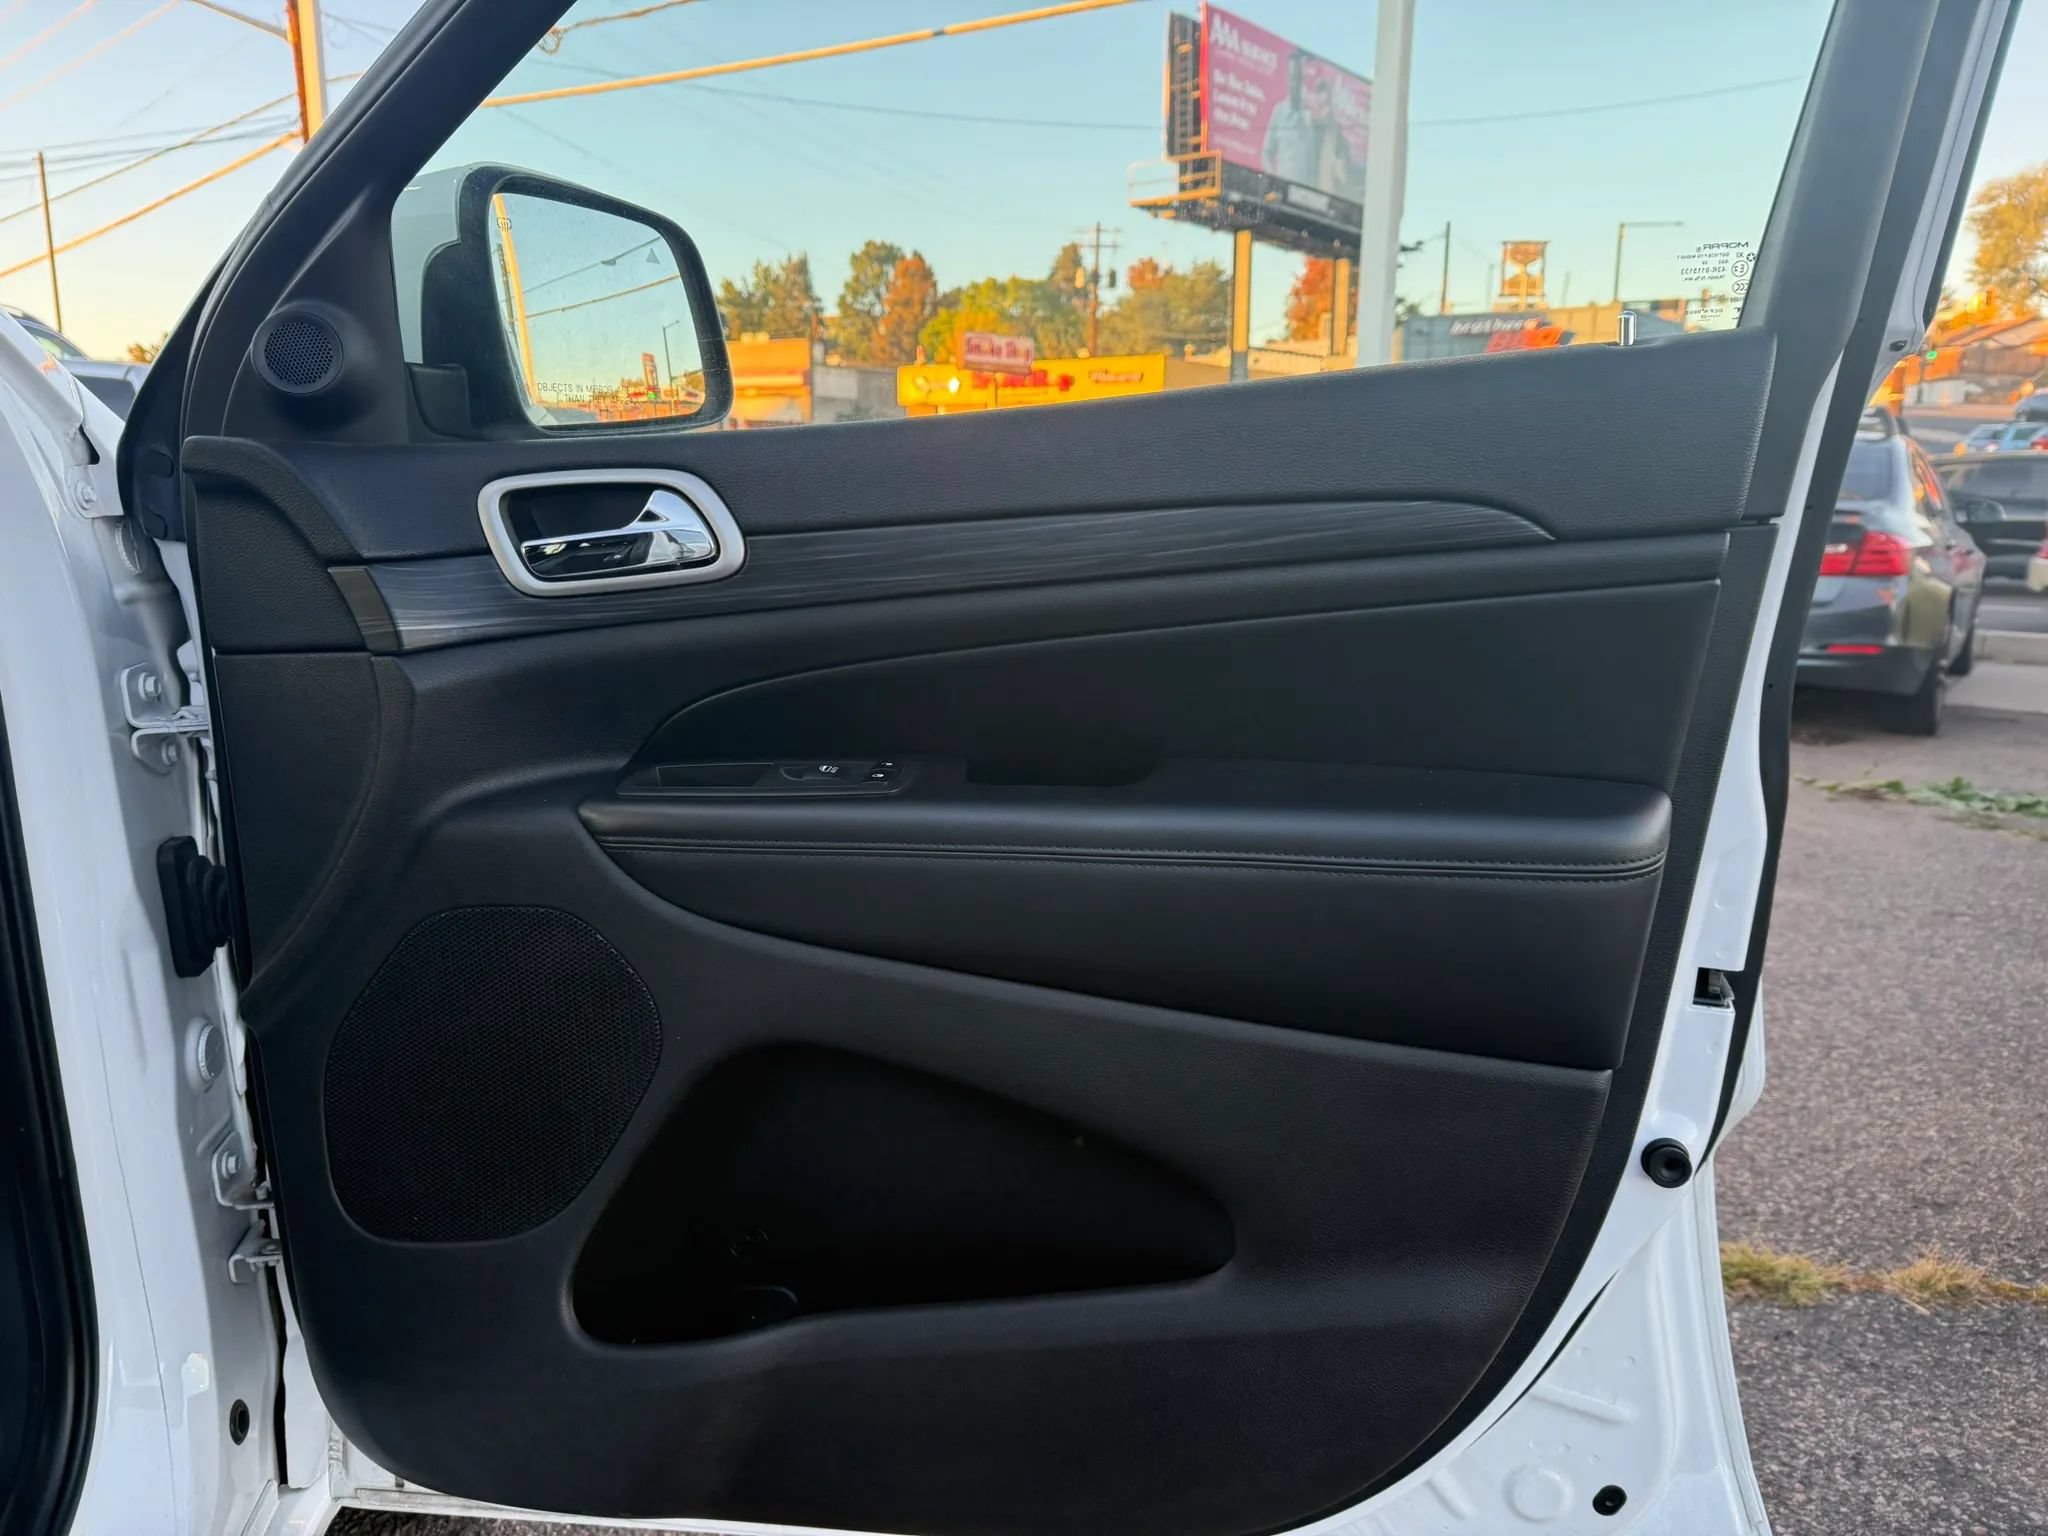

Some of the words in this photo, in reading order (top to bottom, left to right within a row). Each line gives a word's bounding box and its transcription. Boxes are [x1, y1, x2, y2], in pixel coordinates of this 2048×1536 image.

[537, 382, 573, 392] OBJECTS
[576, 384, 584, 392] IN
[564, 394, 585, 403] THAN
